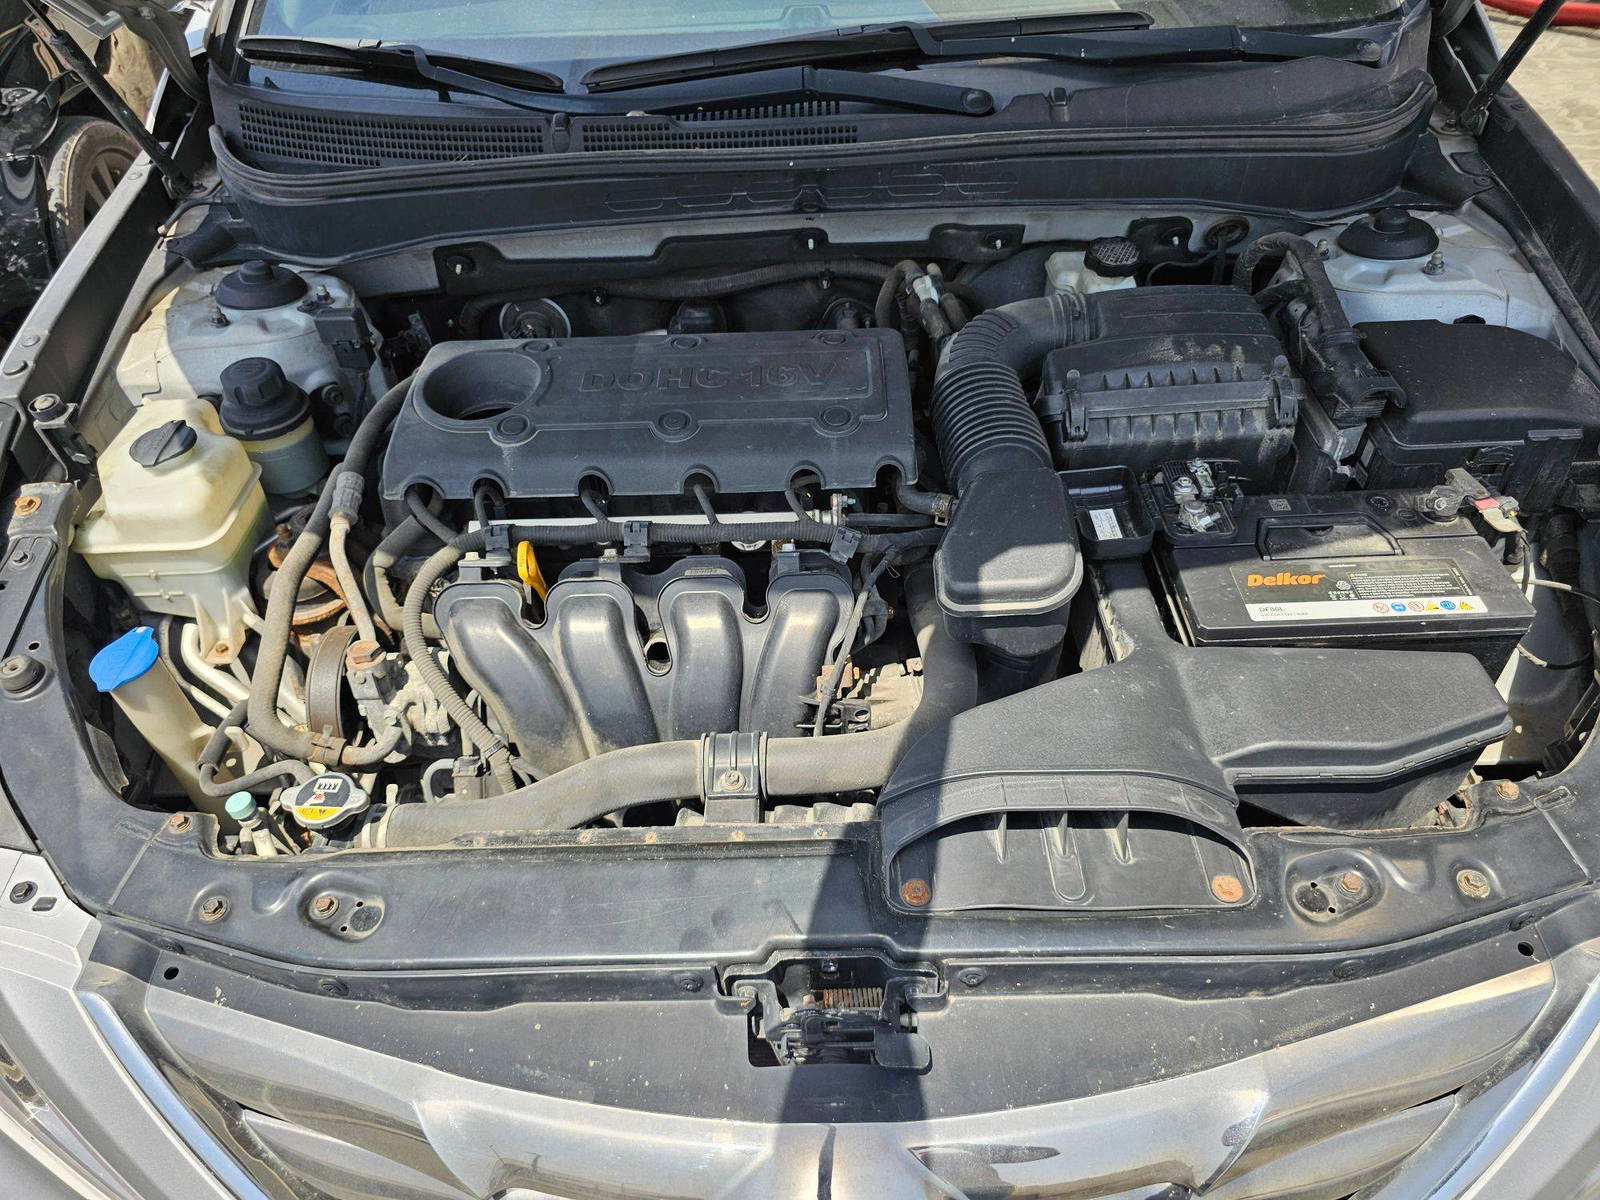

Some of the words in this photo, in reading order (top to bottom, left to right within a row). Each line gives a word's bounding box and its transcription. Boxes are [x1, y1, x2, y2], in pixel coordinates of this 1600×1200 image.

[579, 364, 730, 392] DOHC
[740, 358, 838, 387] 16V
[1247, 572, 1326, 587] Delkor
